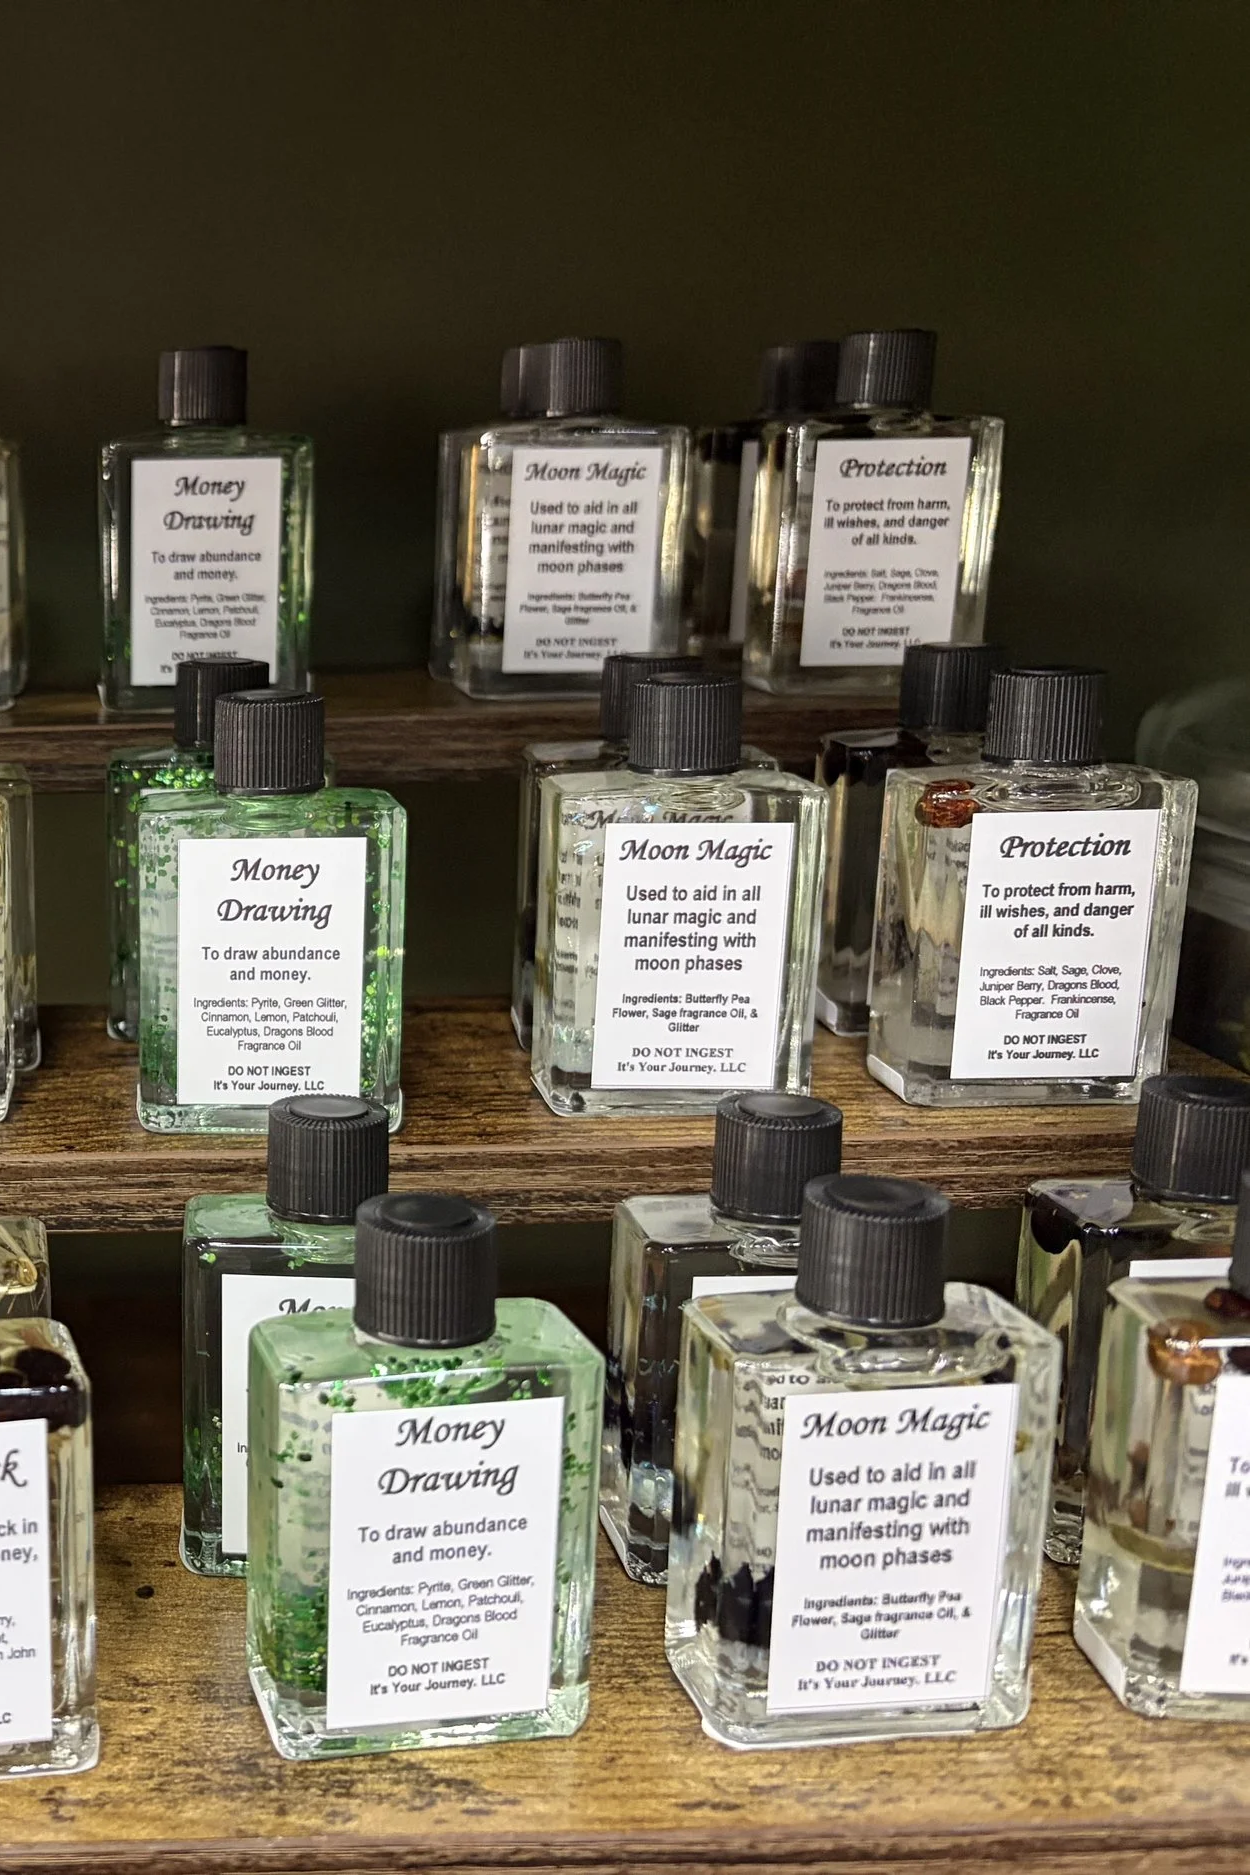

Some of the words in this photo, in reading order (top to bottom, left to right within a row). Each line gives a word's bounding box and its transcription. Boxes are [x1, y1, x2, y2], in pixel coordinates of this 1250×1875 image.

[524, 462, 581, 481] Moon
[585, 461, 646, 487] Magic
[839, 455, 947, 478] Protection
[174, 475, 246, 502] Money
[530, 501, 564, 515] Used
[567, 502, 579, 514] to
[583, 500, 603, 514] aid
[606, 500, 619, 514] in
[622, 501, 638, 514] all
[825, 499, 840, 512] To
[842, 498, 884, 514] protect
[887, 497, 914, 510] from
[917, 497, 950, 511] harm,
[163, 508, 255, 536] Drawing
[531, 520, 565, 534] lunar
[568, 520, 606, 537] magic
[610, 520, 634, 534] and
[824, 516, 834, 528] ill
[836, 516, 880, 529] wishes,
[883, 515, 905, 528] and
[907, 514, 950, 530] danger
[851, 532, 864, 546] of
[865, 532, 880, 546] all
[882, 532, 916, 545] kinds.
[151, 551, 165, 563] To
[168, 551, 196, 563] draw
[199, 550, 261, 562] abundance
[528, 539, 604, 557] manifesting
[607, 540, 634, 553] with
[173, 568, 194, 580] and
[197, 570, 237, 582] money.
[537, 562, 574, 573] moon
[577, 559, 624, 575] phases
[618, 838, 689, 861] Moon
[695, 838, 773, 868] Magic
[999, 832, 1131, 858] Protection
[230, 857, 320, 889] Money
[216, 897, 332, 930] Drawing
[201, 946, 219, 960] To
[223, 946, 258, 960] draw
[262, 946, 340, 960] abundance
[230, 966, 255, 980] and
[260, 970, 310, 984] money.
[979, 966, 1035, 979] Ingredients:
[1037, 965, 1058, 977] Salt,
[1061, 965, 1089, 977] Sage,
[1091, 964, 1122, 976] Clove,
[979, 981, 1014, 993] Juniper
[1016, 980, 1044, 992] Berry,
[1047, 979, 1088, 992] Dragons
[1089, 979, 1120, 991] Blood,
[193, 997, 248, 1010] Ingredients:
[251, 997, 280, 1010] Pyrite,
[283, 997, 313, 1007] Green
[316, 997, 347, 1009] Glitter,
[200, 1011, 251, 1023] Cinnamon,
[254, 1011, 289, 1023] Lemon,
[292, 1011, 338, 1023] Patchouli,
[206, 1025, 260, 1038] Eucalyptus,
[263, 1025, 303, 1038] Dragons
[306, 1025, 333, 1036] Blood
[237, 1040, 285, 1052] Fragrance
[287, 1040, 301, 1050] Oil
[631, 1047, 651, 1057] DO
[654, 1047, 682, 1057] NOT
[685, 1047, 733, 1058] INGEST
[227, 1065, 244, 1076] DO
[246, 1065, 269, 1076] NOT
[271, 1065, 311, 1076] INGEST
[231, 1080, 255, 1090] Your
[304, 1080, 324, 1090] LLC
[800, 1411, 888, 1439] Moon
[895, 1403, 991, 1441] Magic
[394, 1416, 505, 1450] Money
[377, 1460, 520, 1496] Drawing
[809, 1465, 860, 1487] Used
[866, 1466, 886, 1484] to
[891, 1462, 923, 1483] aid
[928, 1461, 946, 1480] in
[952, 1460, 976, 1479] all
[357, 1526, 380, 1543] To
[384, 1524, 428, 1541] draw
[432, 1517, 527, 1537] abundance
[392, 1545, 424, 1564] and
[429, 1544, 491, 1561] money.
[819, 1552, 876, 1570] moon
[881, 1546, 953, 1571] phases
